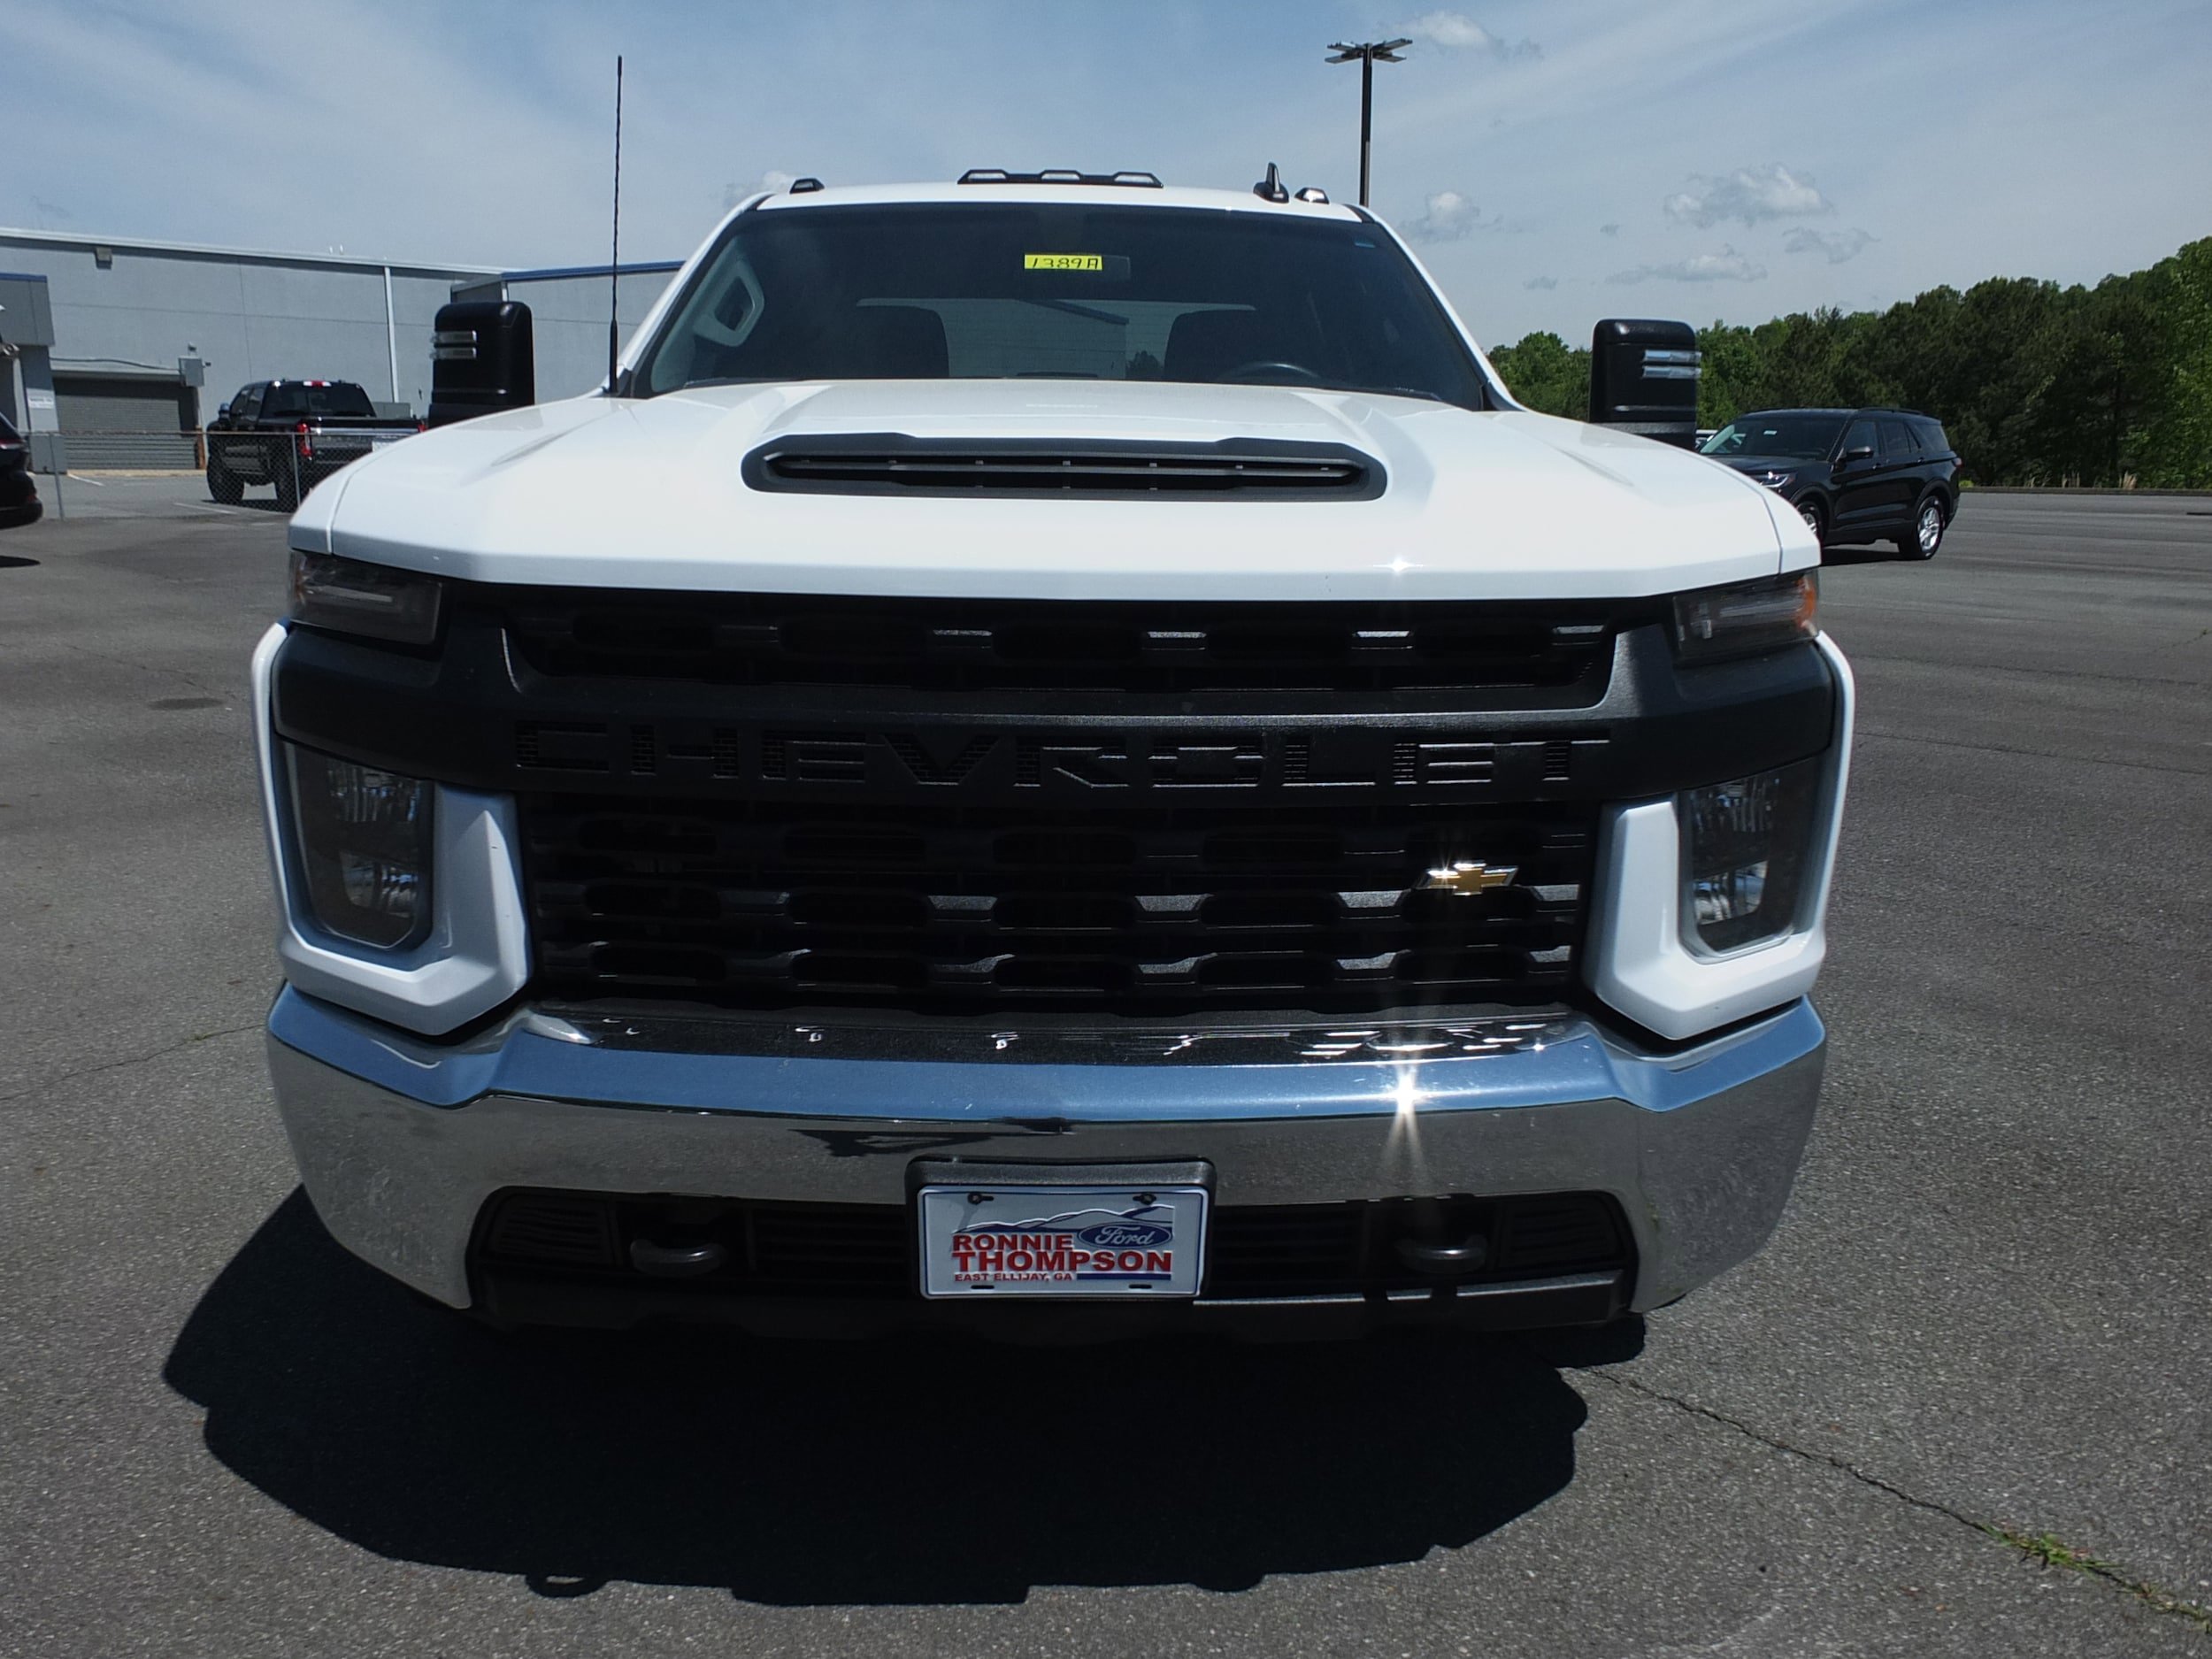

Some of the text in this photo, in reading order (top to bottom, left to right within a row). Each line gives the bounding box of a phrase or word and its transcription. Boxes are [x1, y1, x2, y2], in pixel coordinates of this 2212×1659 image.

[1033, 257, 1099, 269] 1389A
[514, 721, 1610, 788] CHEVROLET
[952, 1233, 1073, 1251] RONNIE
[1094, 1225, 1156, 1246] Ford
[952, 1250, 1172, 1271] THOMPSON
[954, 1272, 1073, 1282] EAST ELLIJAY, GA
